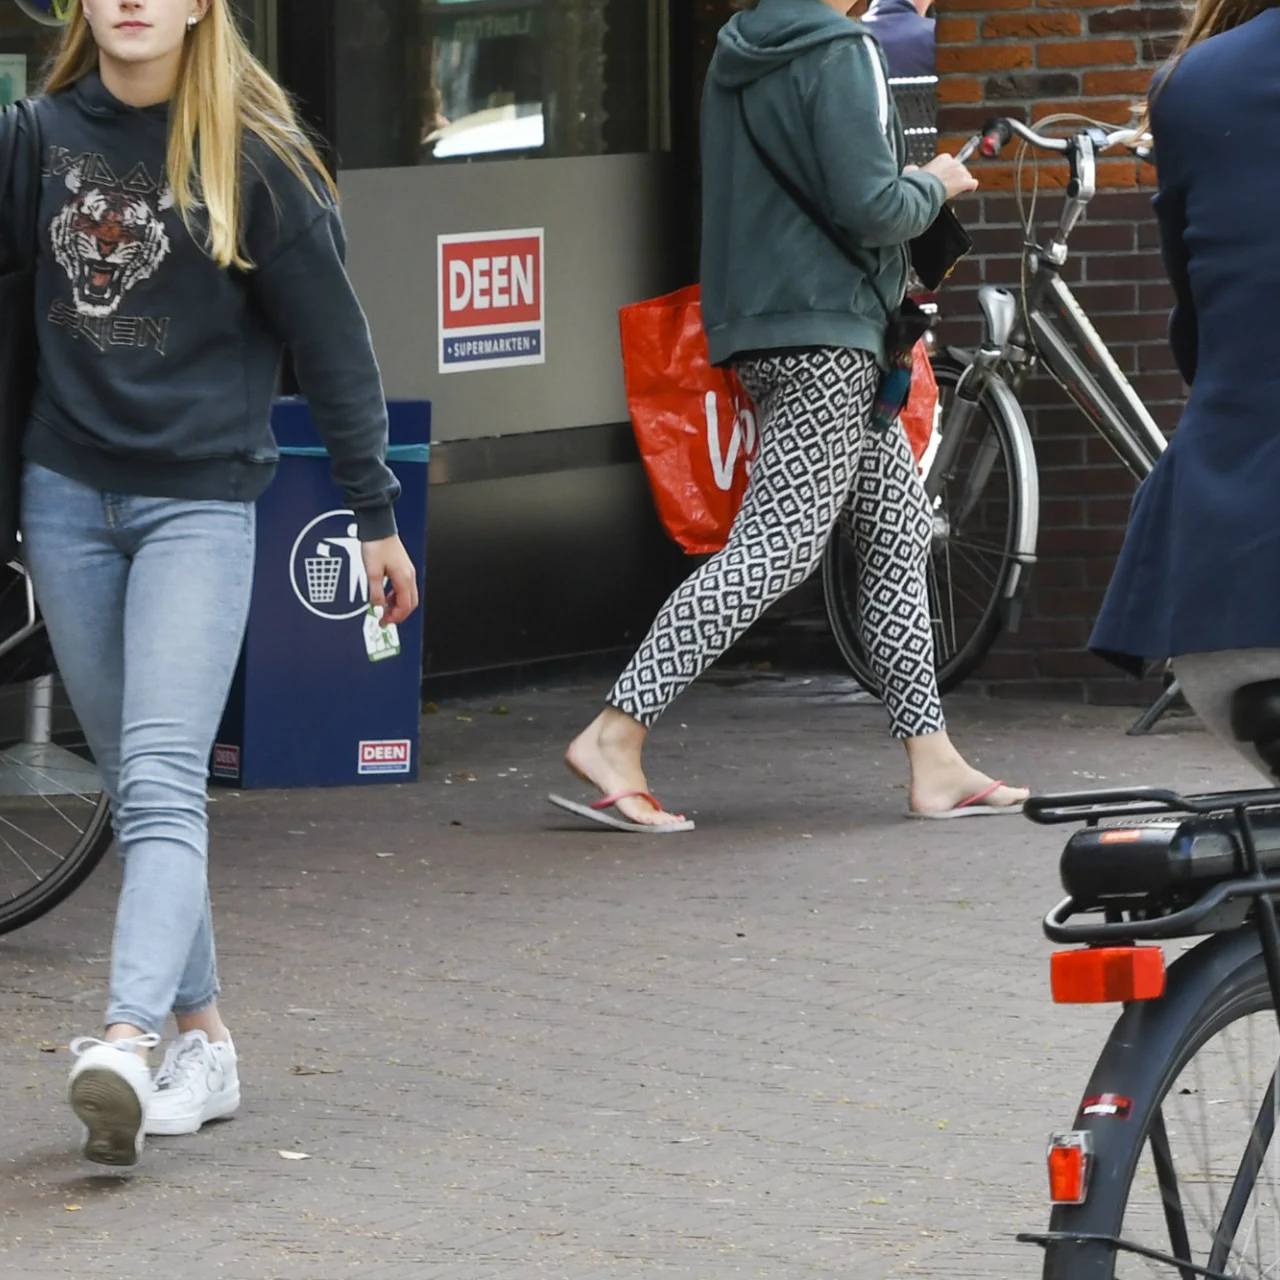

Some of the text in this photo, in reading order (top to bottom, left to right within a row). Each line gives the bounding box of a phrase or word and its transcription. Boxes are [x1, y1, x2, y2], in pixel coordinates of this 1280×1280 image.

[449, 254, 534, 312] DEEN
[454, 336, 531, 358] SUPERMARKTEN
[363, 746, 405, 760] DEEN
